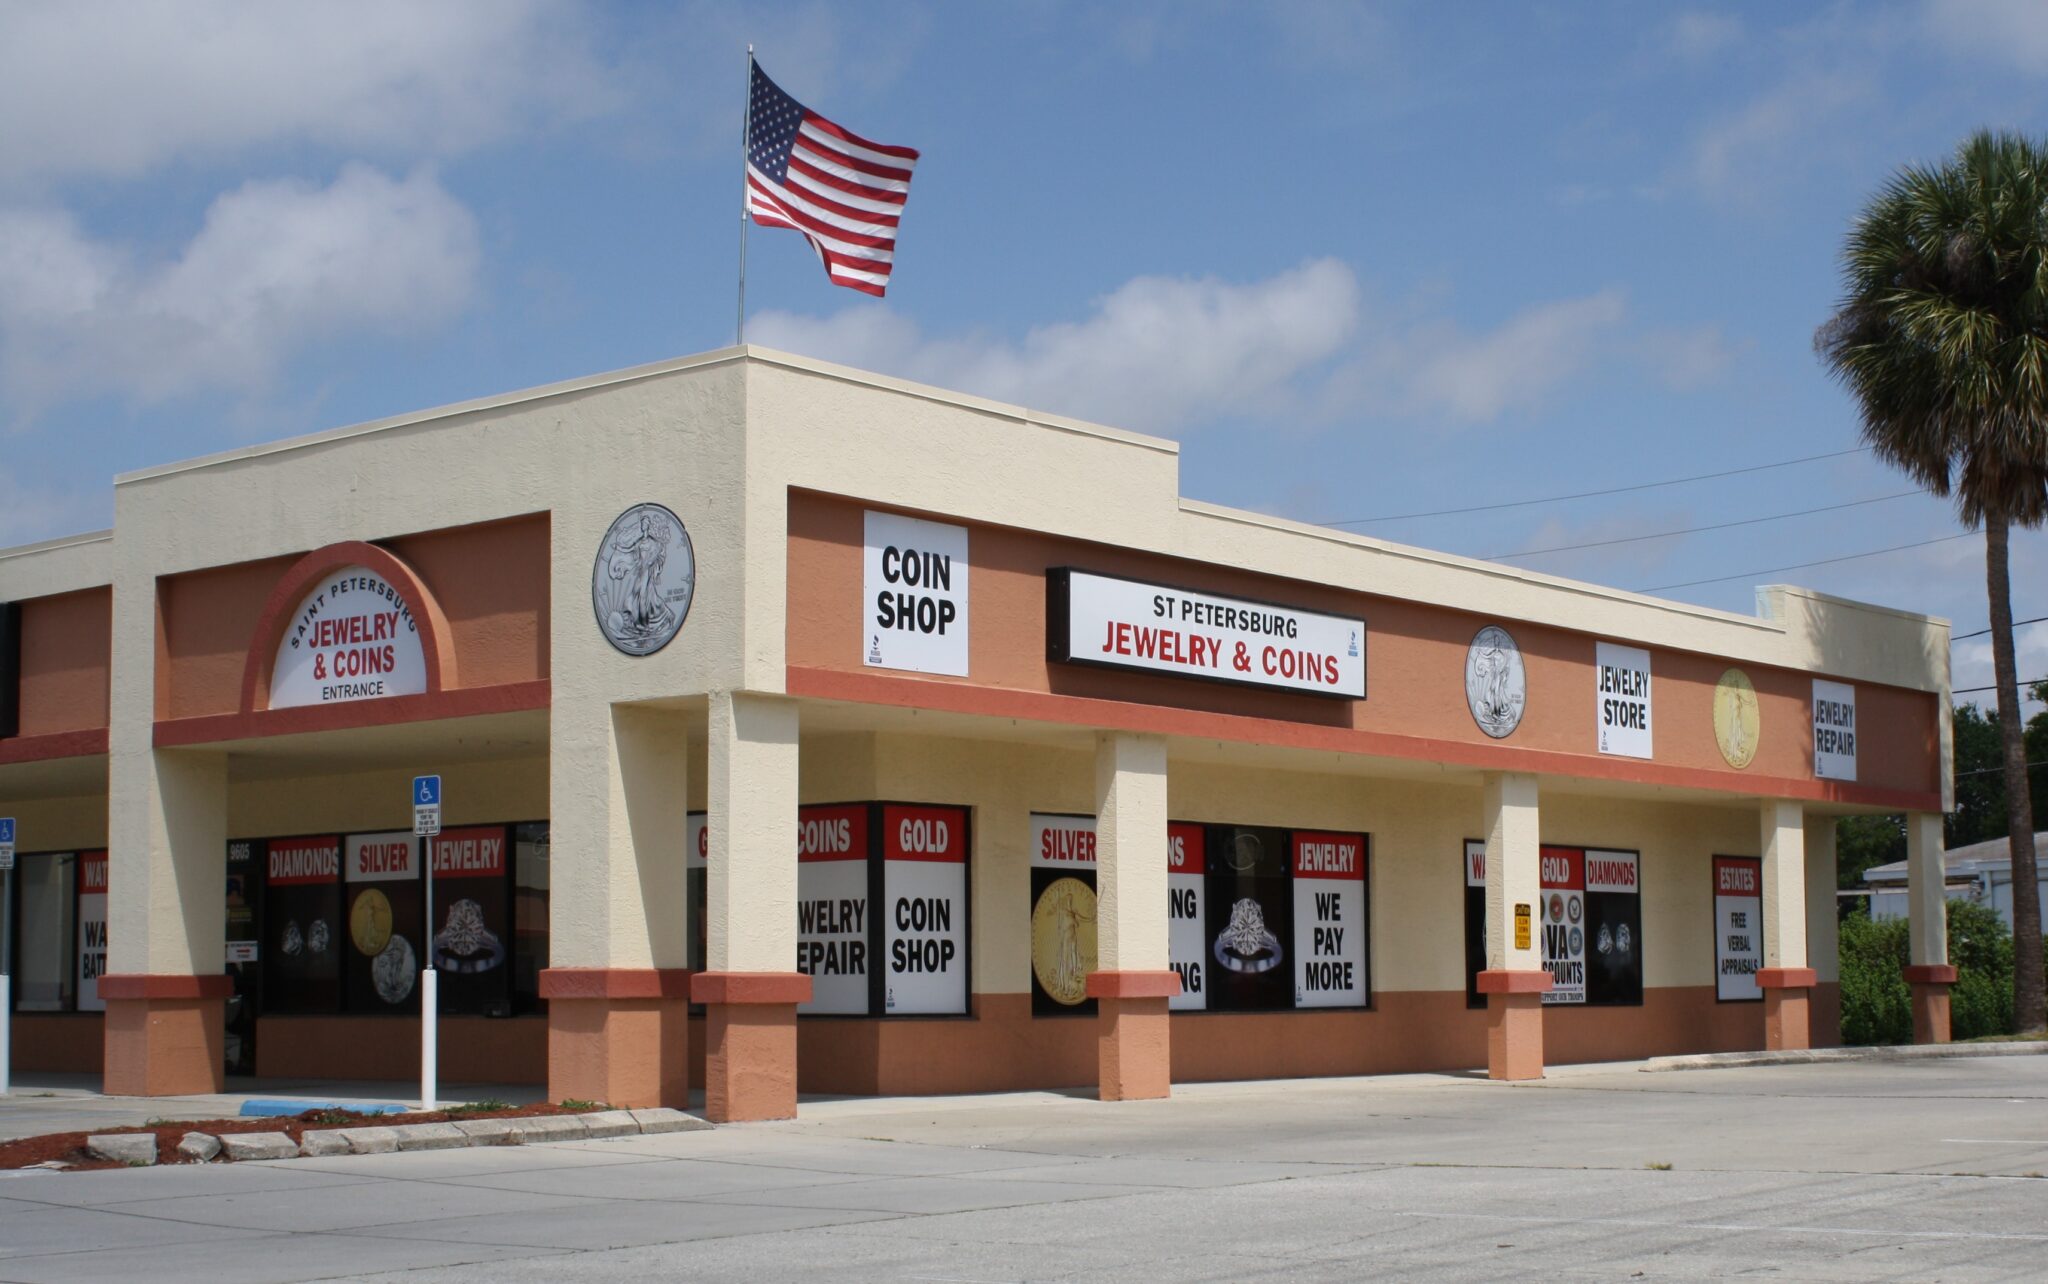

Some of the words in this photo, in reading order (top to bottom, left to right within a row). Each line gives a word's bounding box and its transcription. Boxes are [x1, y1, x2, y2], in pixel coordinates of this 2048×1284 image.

[882, 545, 950, 591] COIN
[291, 595, 325, 649] SAINT
[331, 577, 416, 632] PETERSBURG
[877, 591, 955, 635] SHOP
[1153, 595, 1175, 619] ST
[1182, 600, 1297, 639] PETERSBURG
[308, 611, 400, 648] JEWELRY
[313, 653, 326, 680] &
[333, 645, 395, 678] COINS
[1102, 621, 1222, 668] JEWELRY
[1232, 641, 1251, 672] &
[1262, 646, 1339, 685] COINS
[323, 681, 383, 700] ENTRANCE
[1599, 665, 1648, 698] JEWELRY
[1603, 699, 1646, 730] STORE
[1815, 699, 1853, 728] JEWELRY
[1816, 728, 1854, 756] REPAIR
[900, 818, 948, 853] GOLD
[1042, 828, 1096, 861] SILVER
[269, 845, 339, 879] DIAMONDS
[359, 842, 408, 873] SILVER
[433, 838, 501, 872] JEWELRY
[1298, 843, 1356, 872] JEWELRY
[1542, 857, 1569, 883] GOLD
[1588, 860, 1635, 886] DIAMONDS
[1720, 867, 1754, 891] ESTATES
[895, 897, 950, 932] COIN
[1315, 893, 1341, 921] WE
[1731, 912, 1746, 928] FREE
[891, 939, 955, 973] SHOP
[1314, 927, 1344, 956] PAY
[1546, 925, 1568, 959] VA
[1728, 936, 1751, 951] VERBAL
[1305, 962, 1353, 990] MORE
[1721, 959, 1758, 975] APPRAISALS
